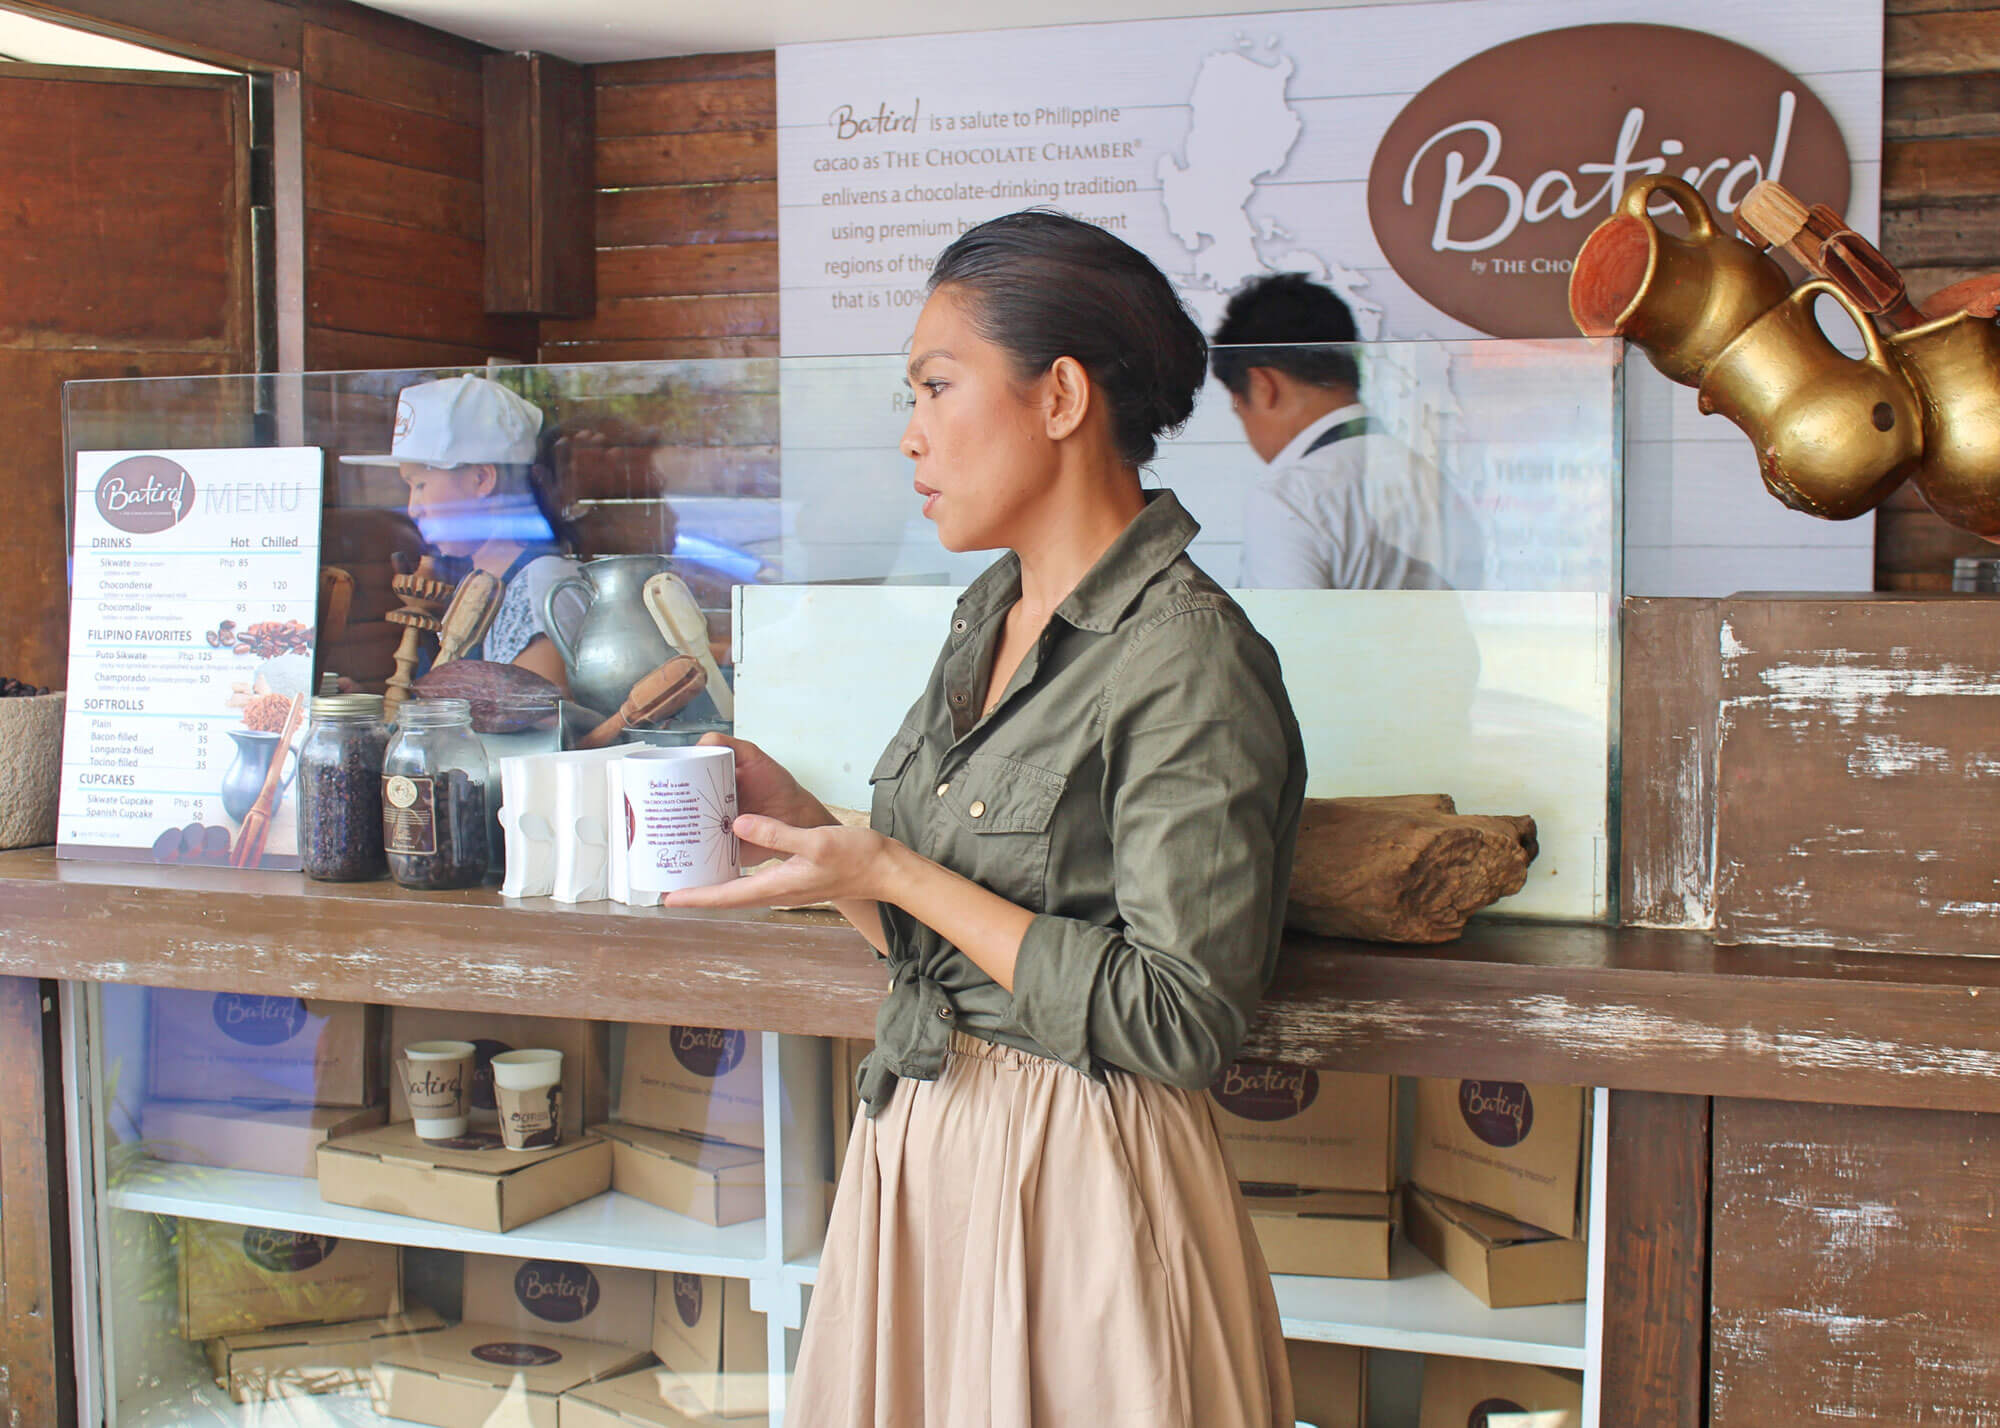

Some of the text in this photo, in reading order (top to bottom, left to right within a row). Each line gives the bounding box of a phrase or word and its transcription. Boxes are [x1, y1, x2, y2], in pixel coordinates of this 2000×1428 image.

[929, 113, 941, 131] is
[945, 116, 955, 130] a
[960, 110, 1008, 129] salute
[1013, 111, 1030, 127] to
[1035, 105, 1121, 127] Philippine
[813, 157, 859, 172] cacao
[863, 155, 880, 169] as
[885, 151, 920, 168] THE
[926, 146, 1037, 166] CHOCOLATE
[822, 176, 1137, 206] enlivens a chocolate-drinking tradition
[831, 223, 874, 243] using
[879, 219, 953, 241] premium
[825, 254, 935, 278] regions of the
[1491, 258, 1527, 273] THE
[832, 291, 864, 309] that
[868, 291, 880, 308] is
[205, 482, 302, 514] MENU
[92, 537, 132, 549] DRINKS
[230, 536, 299, 548] Hot Chilled
[100, 558, 131, 568] Sikwate
[272, 581, 288, 591] 120
[271, 603, 287, 613] 120
[88, 629, 192, 642] FILIPINO FAVORITES
[84, 699, 145, 711] SOFTROLLS
[79, 772, 136, 786] CUPCAKES
